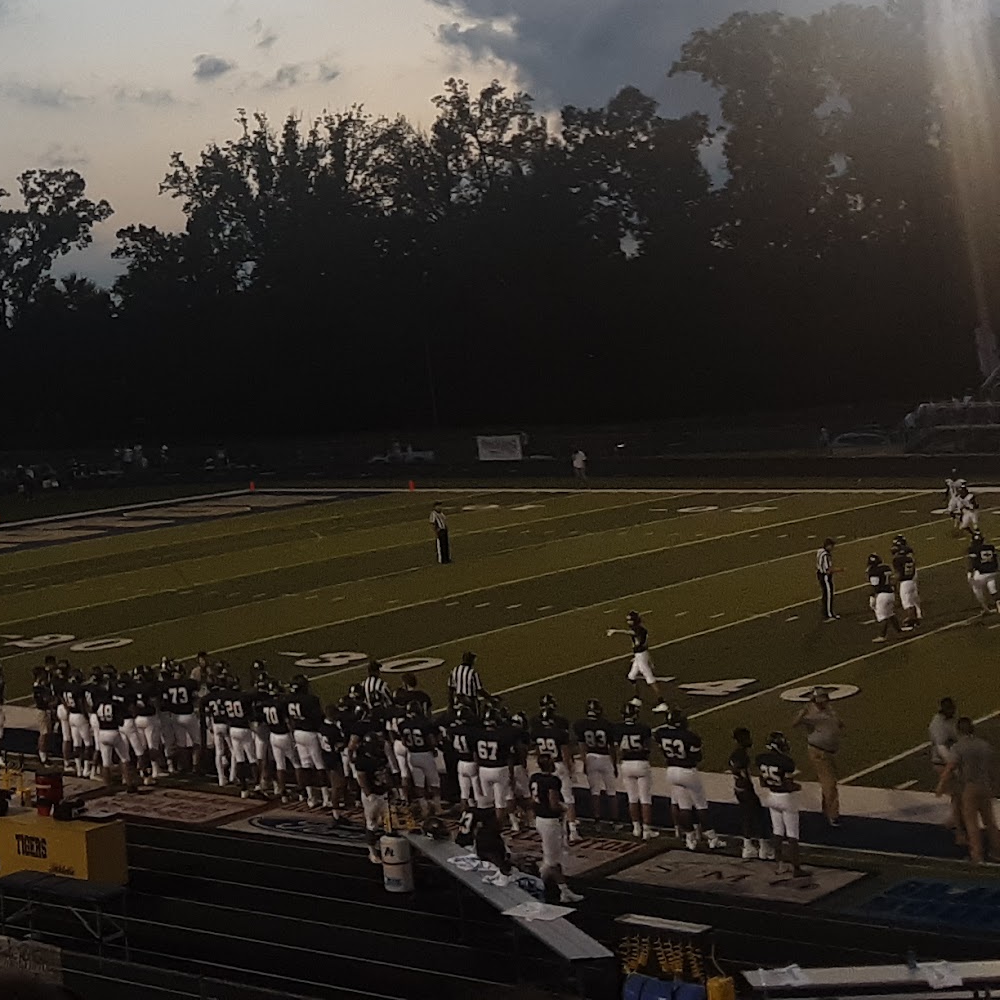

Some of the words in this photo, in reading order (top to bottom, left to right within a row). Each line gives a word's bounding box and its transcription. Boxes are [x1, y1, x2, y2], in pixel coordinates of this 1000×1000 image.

[168, 686, 189, 705] 73
[224, 699, 245, 719] 20
[476, 739, 499, 761] 67
[620, 734, 642, 751] 45
[660, 737, 686, 759] 53
[14, 833, 48, 859] TIGERS
